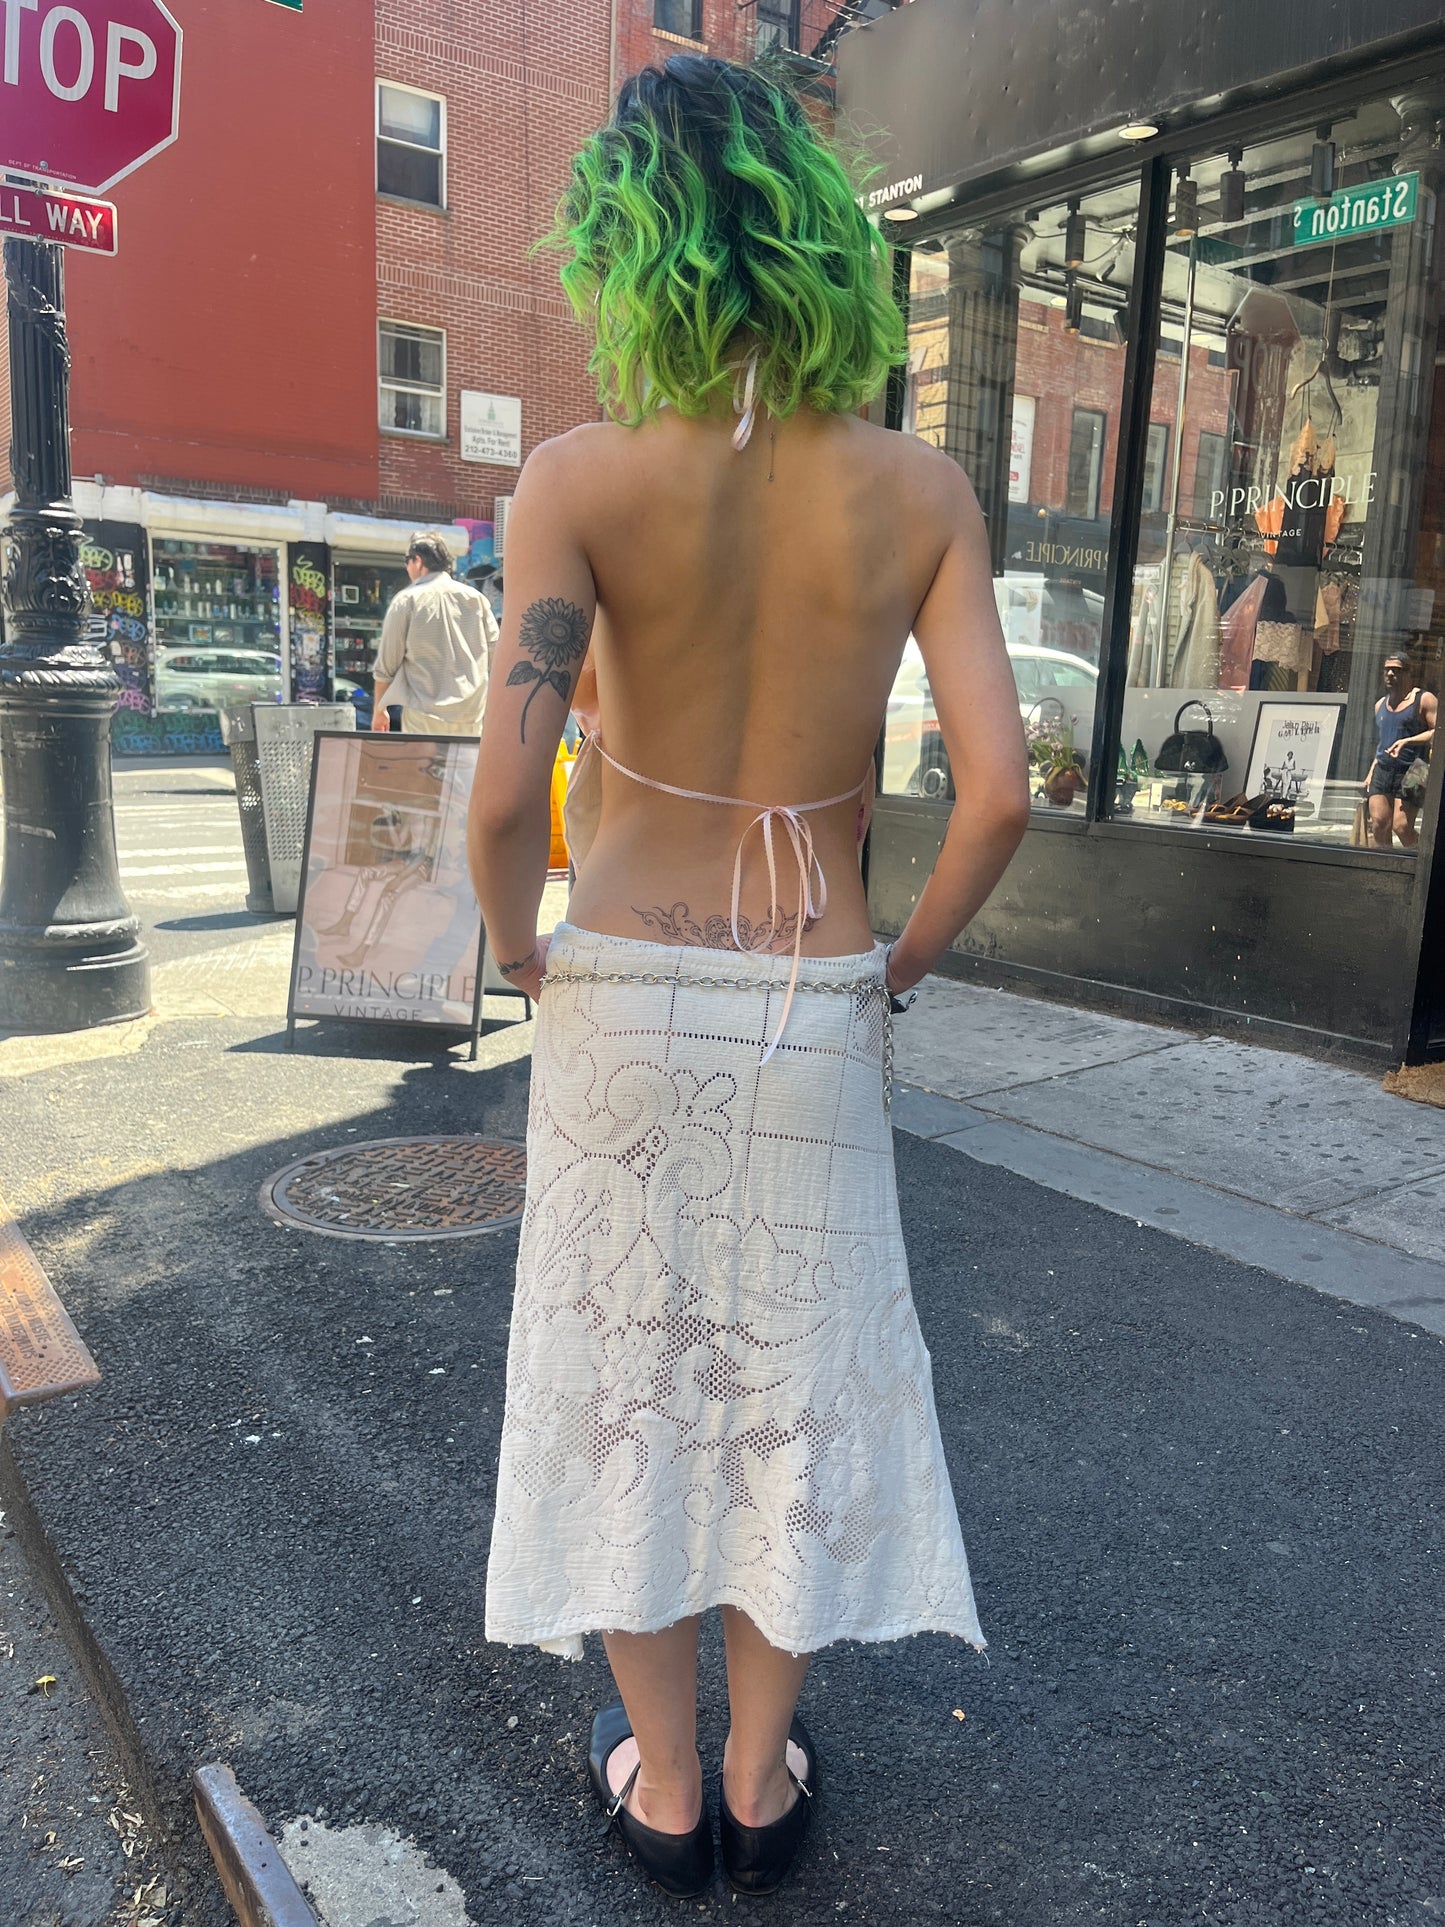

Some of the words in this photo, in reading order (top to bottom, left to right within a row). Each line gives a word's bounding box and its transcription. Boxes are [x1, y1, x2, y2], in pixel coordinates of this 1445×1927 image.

[868, 173, 923, 207] STANTON
[45, 202, 103, 240] WAY
[320, 968, 477, 1004] PRINCIPLE
[334, 1003, 423, 1022] VINTAGE
